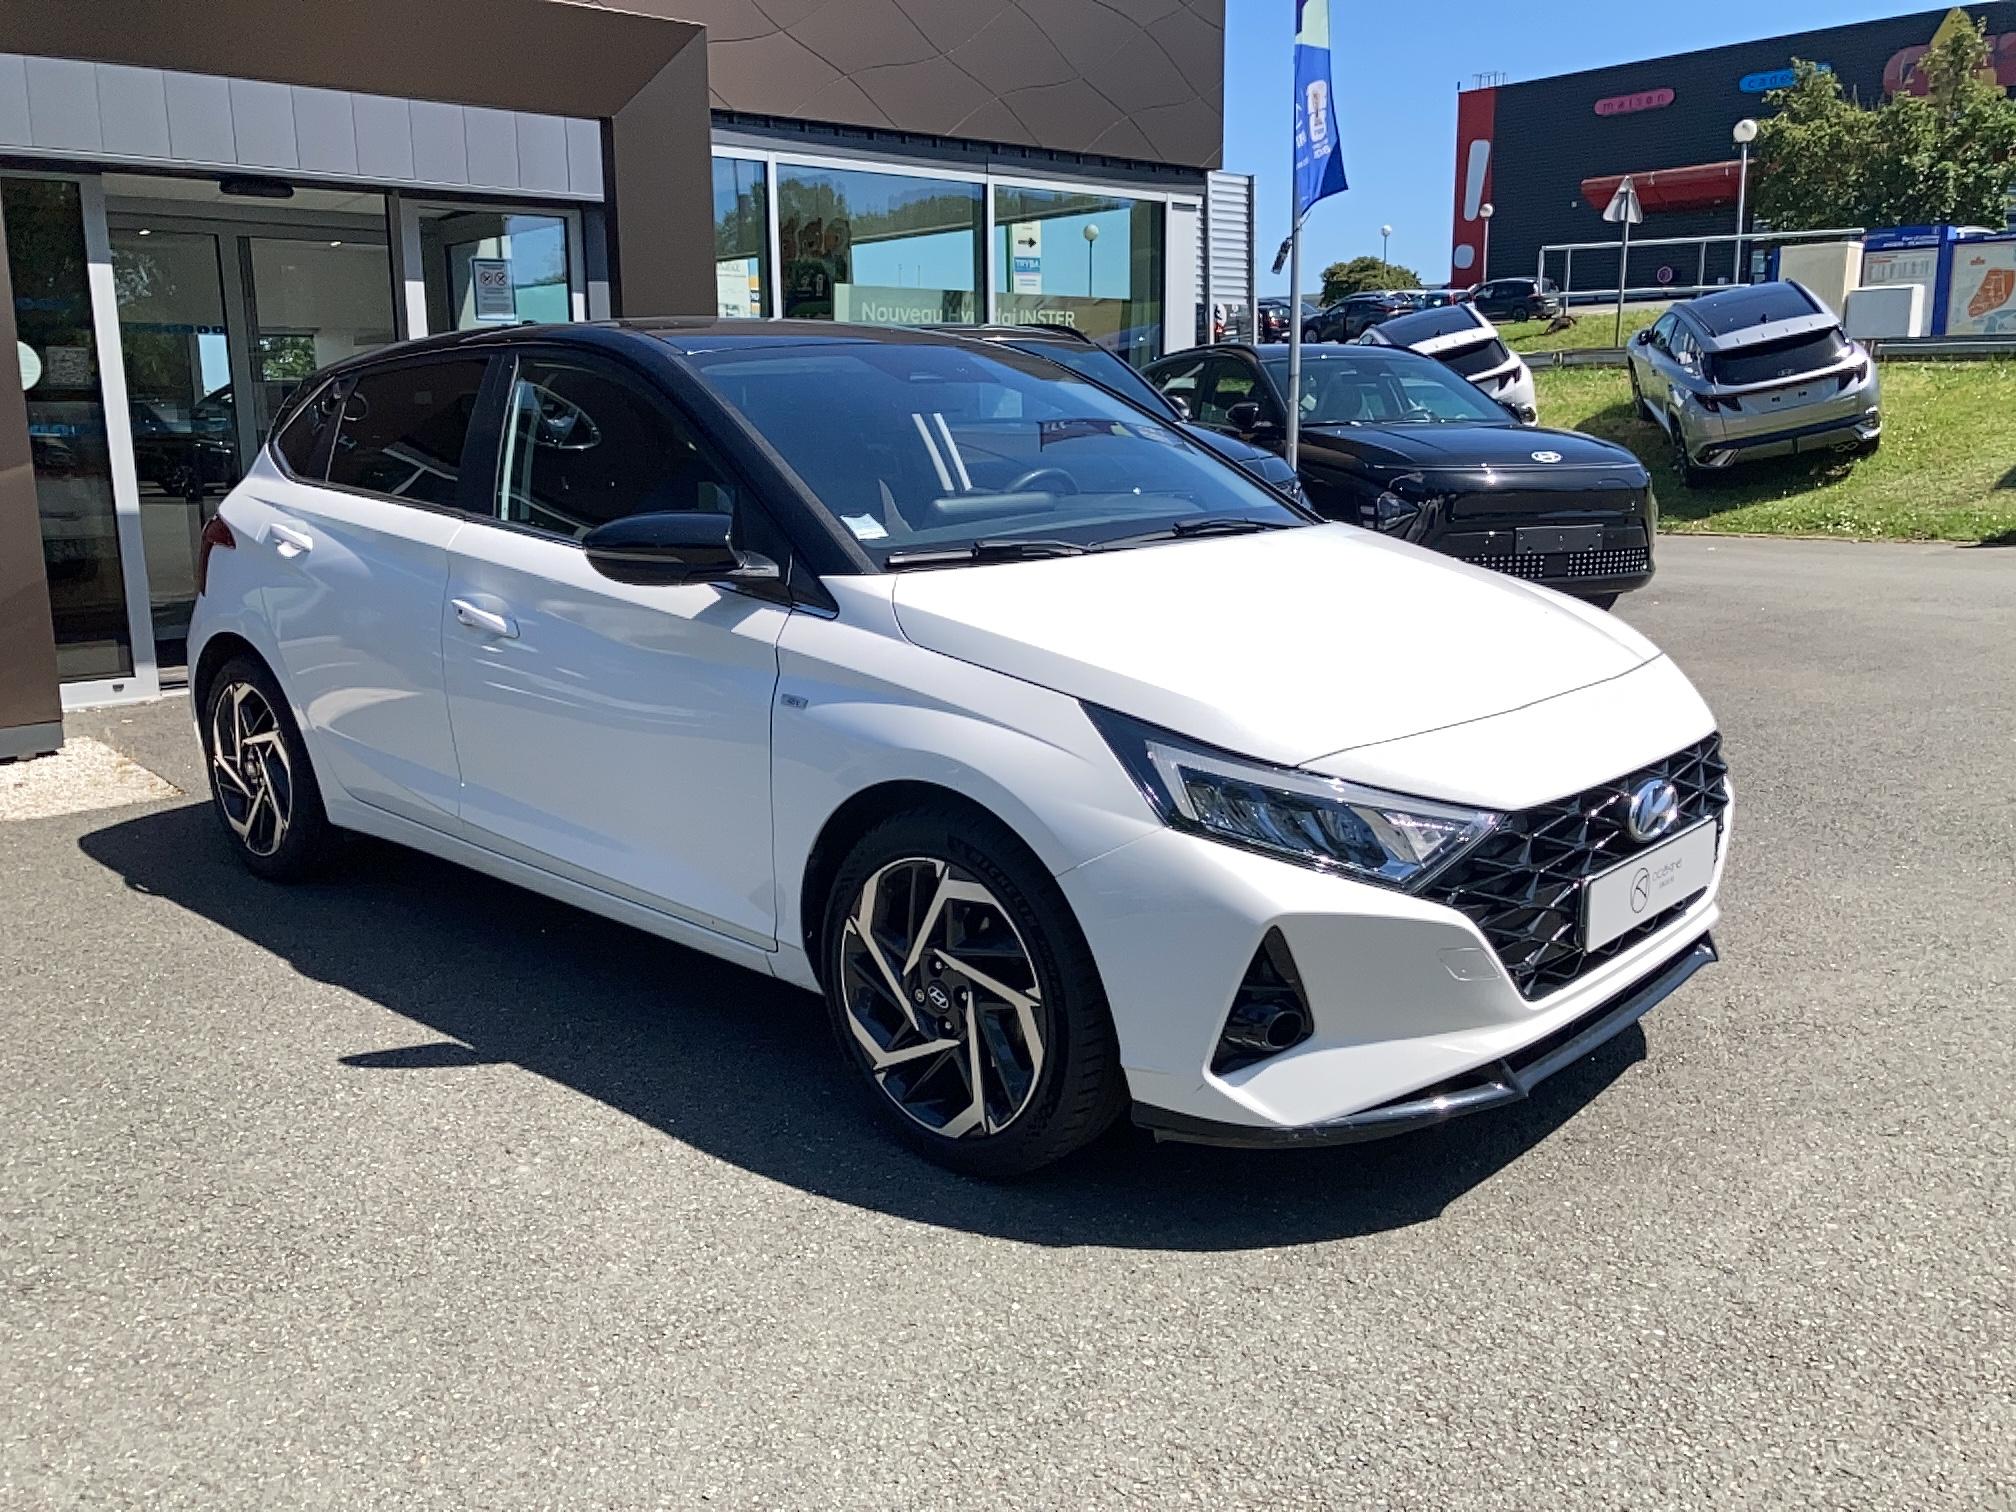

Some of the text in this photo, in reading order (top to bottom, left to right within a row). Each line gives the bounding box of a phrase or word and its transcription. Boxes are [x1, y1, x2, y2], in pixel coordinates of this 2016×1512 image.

[1603, 94, 1664, 112] maison
[861, 302, 943, 324] Nouveau
[1019, 310, 1075, 328] INSTER
